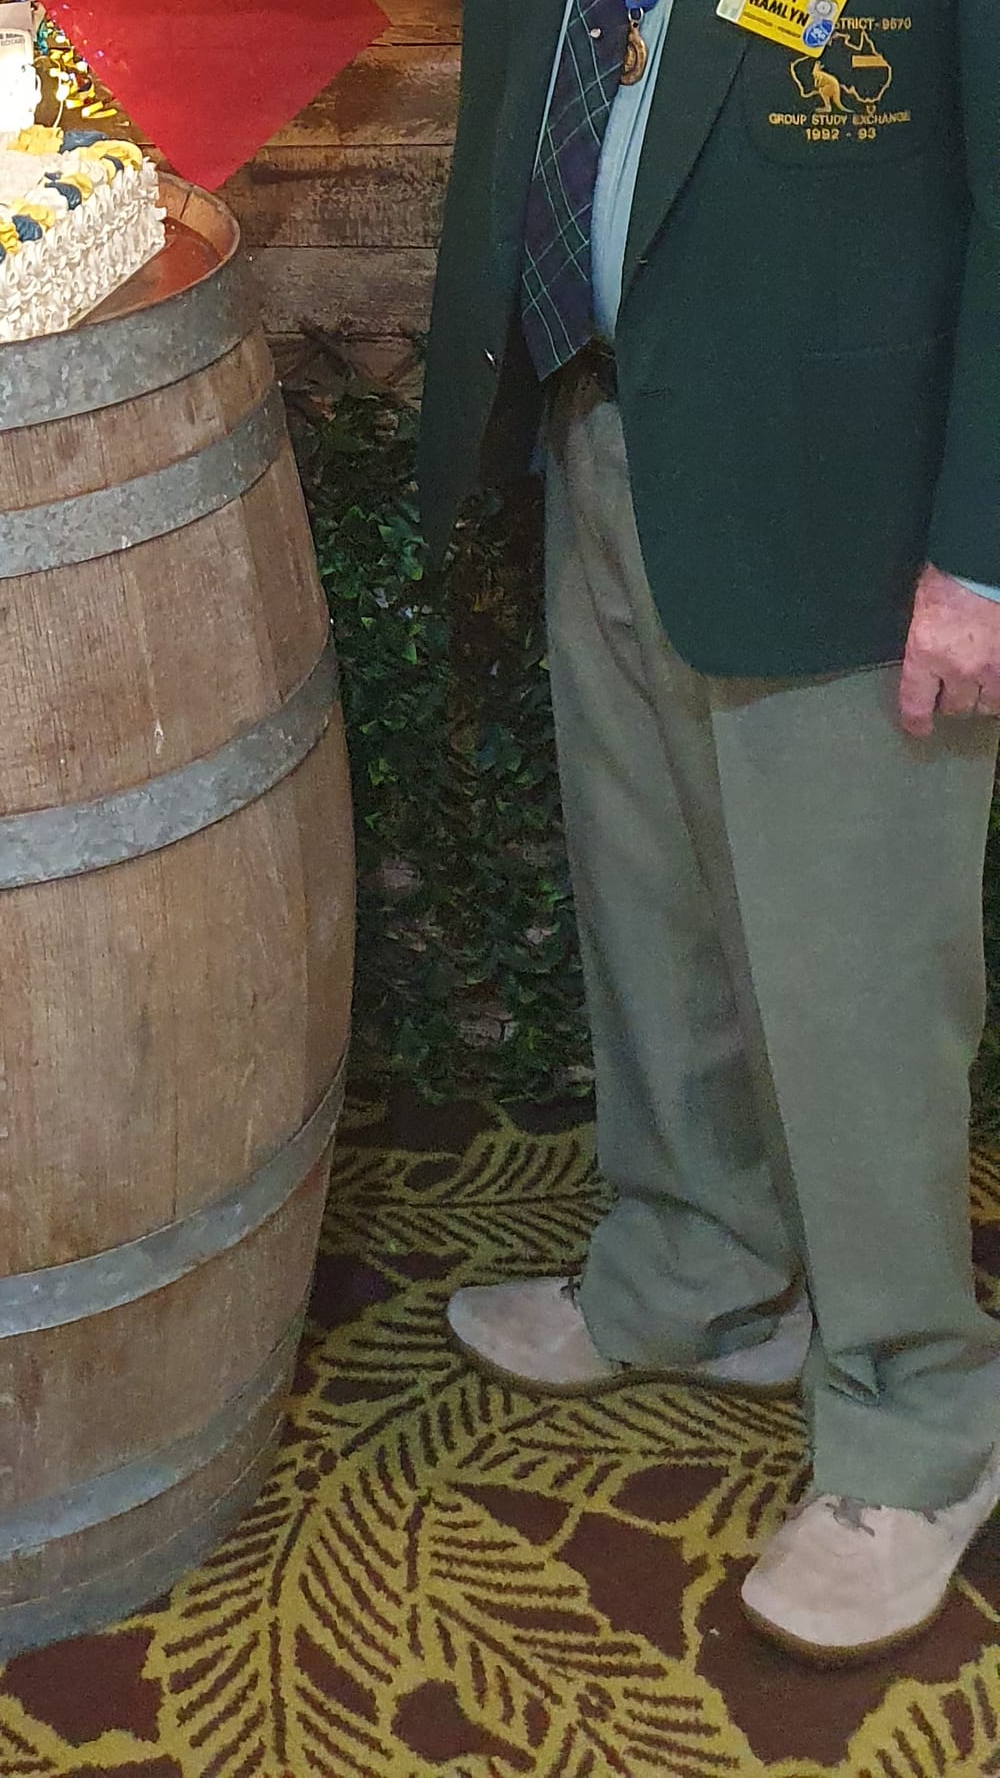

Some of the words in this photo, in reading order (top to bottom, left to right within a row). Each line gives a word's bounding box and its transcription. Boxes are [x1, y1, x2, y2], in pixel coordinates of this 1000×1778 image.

[768, 112, 807, 125] GROUP
[811, 114, 848, 125] STUDY
[852, 111, 911, 125] EXCHANGE
[805, 128, 840, 141] 1992
[858, 128, 877, 140] 93
